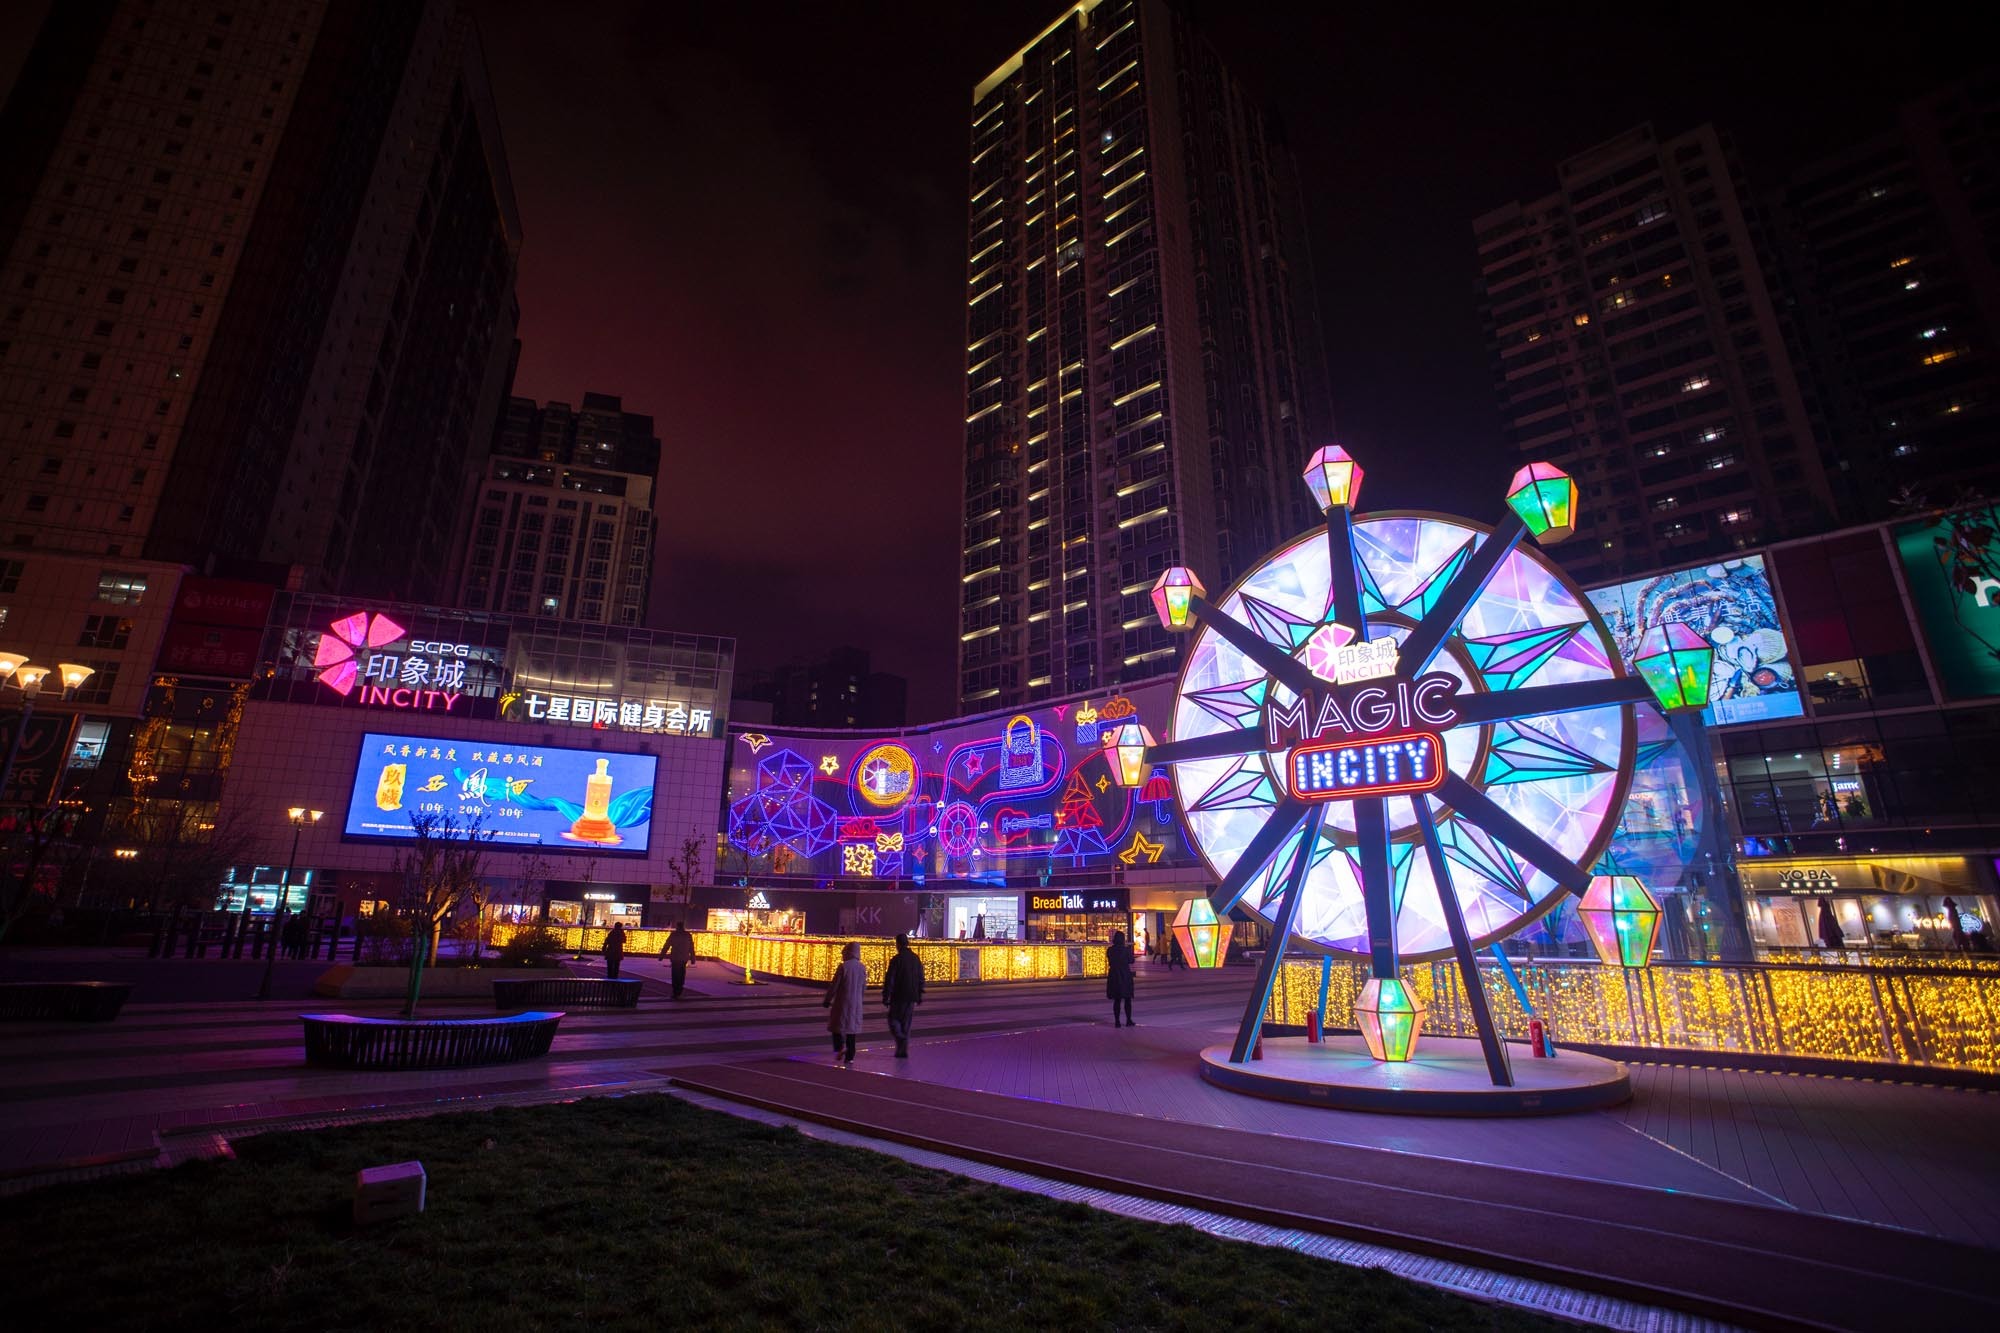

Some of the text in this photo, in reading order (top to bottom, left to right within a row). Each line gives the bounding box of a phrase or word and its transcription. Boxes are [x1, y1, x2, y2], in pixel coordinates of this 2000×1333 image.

[410, 640, 470, 657] SCPG
[1338, 640, 1395, 666] 印象城
[365, 653, 466, 689] 印象城
[1340, 660, 1396, 681] INCITY
[360, 685, 460, 711] INCITY
[524, 694, 711, 732] 七星国际健身会所
[1267, 678, 1457, 745] MAGIC
[1296, 740, 1430, 791] INCITY
[1033, 894, 1084, 909] BreadTalk
[856, 906, 882, 924] KK
